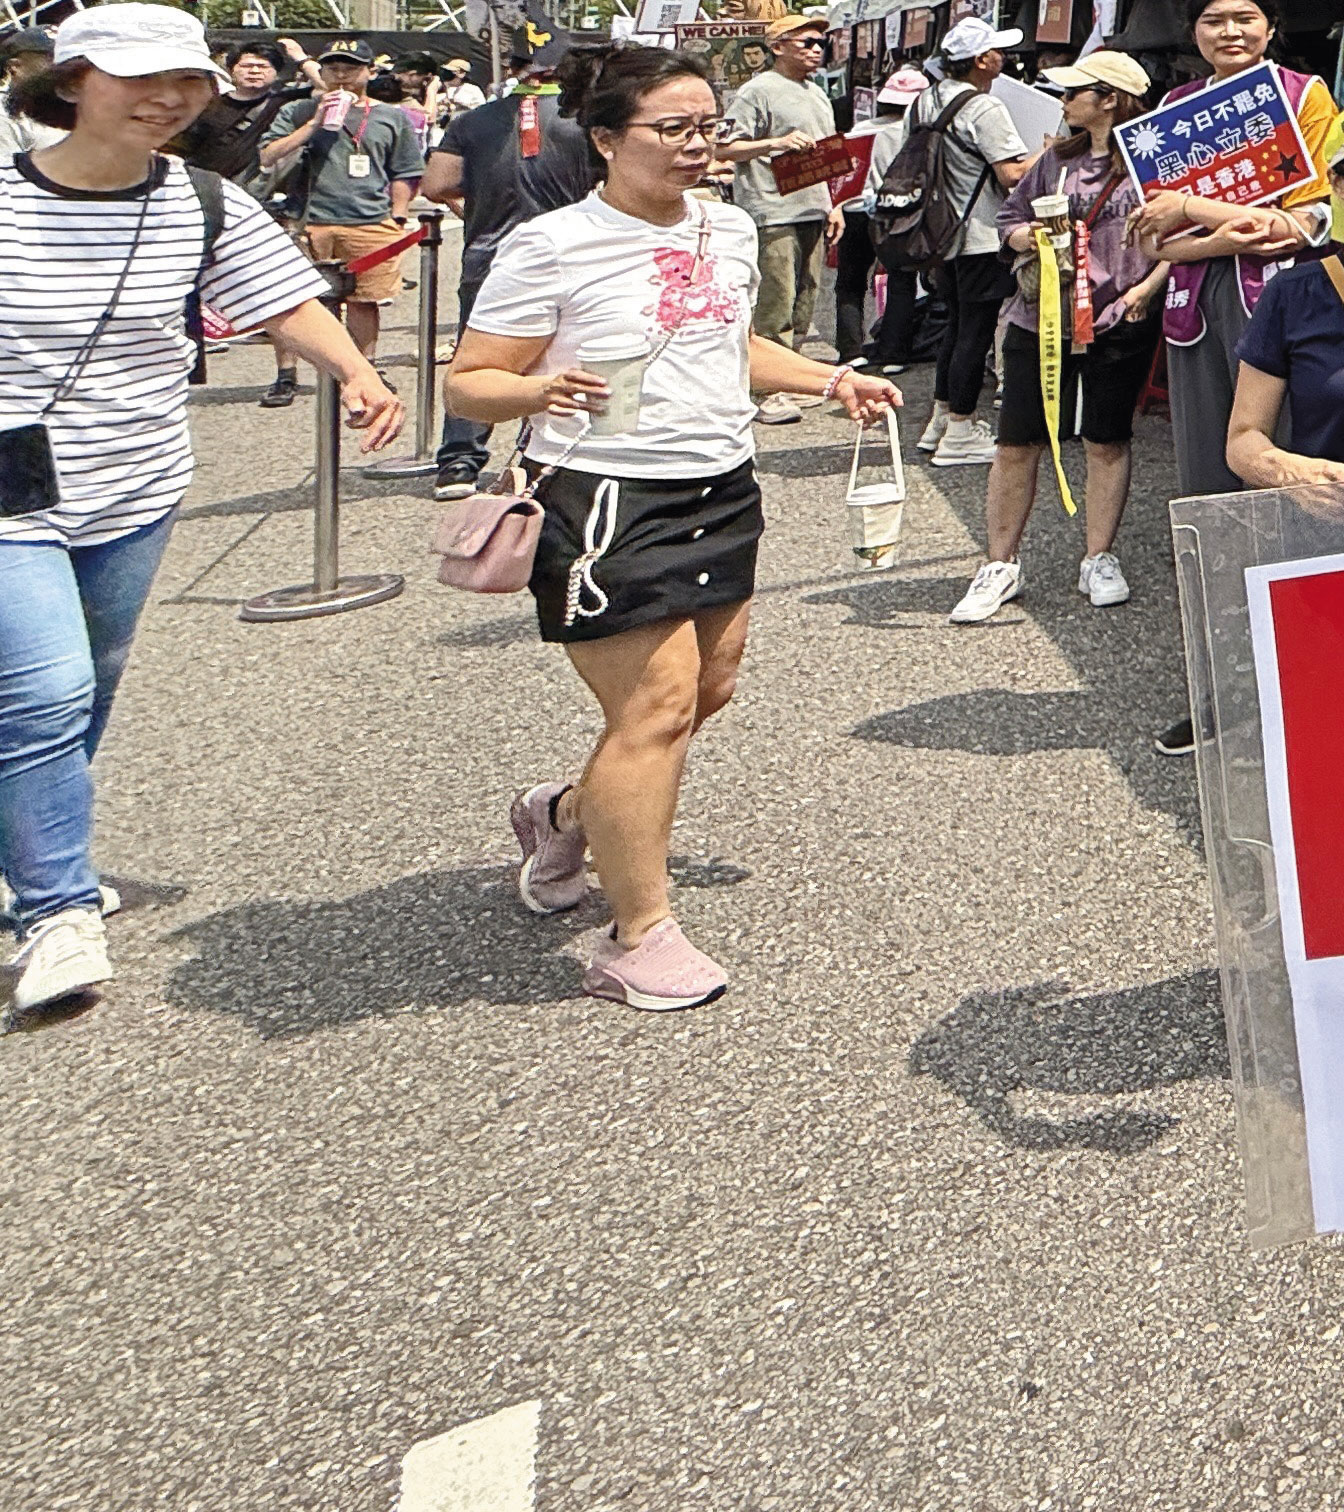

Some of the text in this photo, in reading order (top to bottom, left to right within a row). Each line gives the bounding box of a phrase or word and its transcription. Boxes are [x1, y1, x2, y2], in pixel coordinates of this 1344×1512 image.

[709, 25, 741, 37] CAN
[1171, 82, 1278, 139] 今日不罷免
[1154, 111, 1277, 187] 黑心立委
